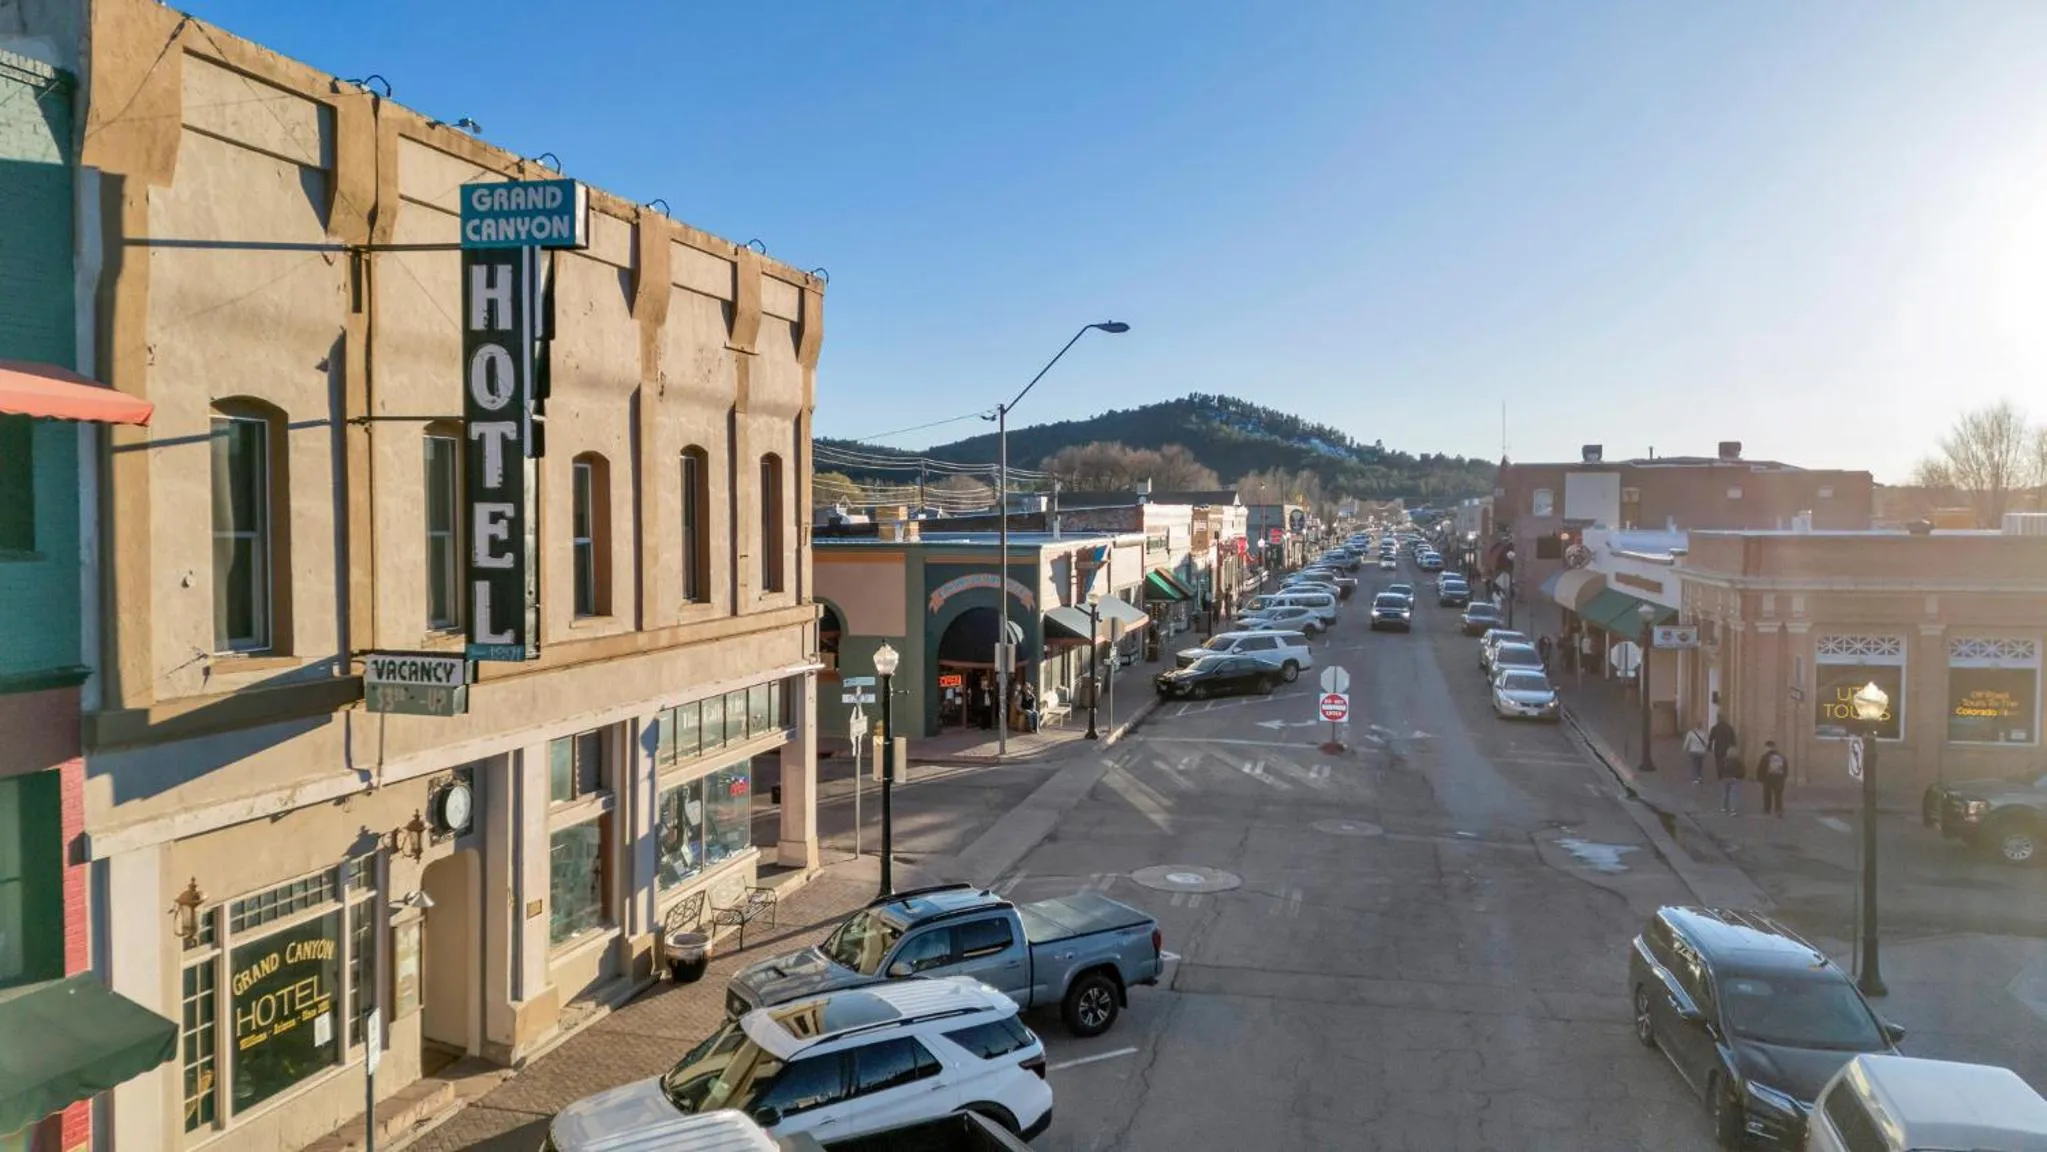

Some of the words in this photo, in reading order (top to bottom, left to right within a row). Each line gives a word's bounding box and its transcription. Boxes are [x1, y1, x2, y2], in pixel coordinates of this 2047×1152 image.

[471, 185, 563, 212] GRAND
[465, 215, 570, 241] CANYON
[468, 264, 517, 645] HOTEL
[371, 659, 457, 683] VACANCY
[1823, 703, 1892, 720] TOUS
[232, 952, 280, 996] GRAND
[286, 938, 335, 964] CANYON
[236, 975, 331, 1037] HOTEL
